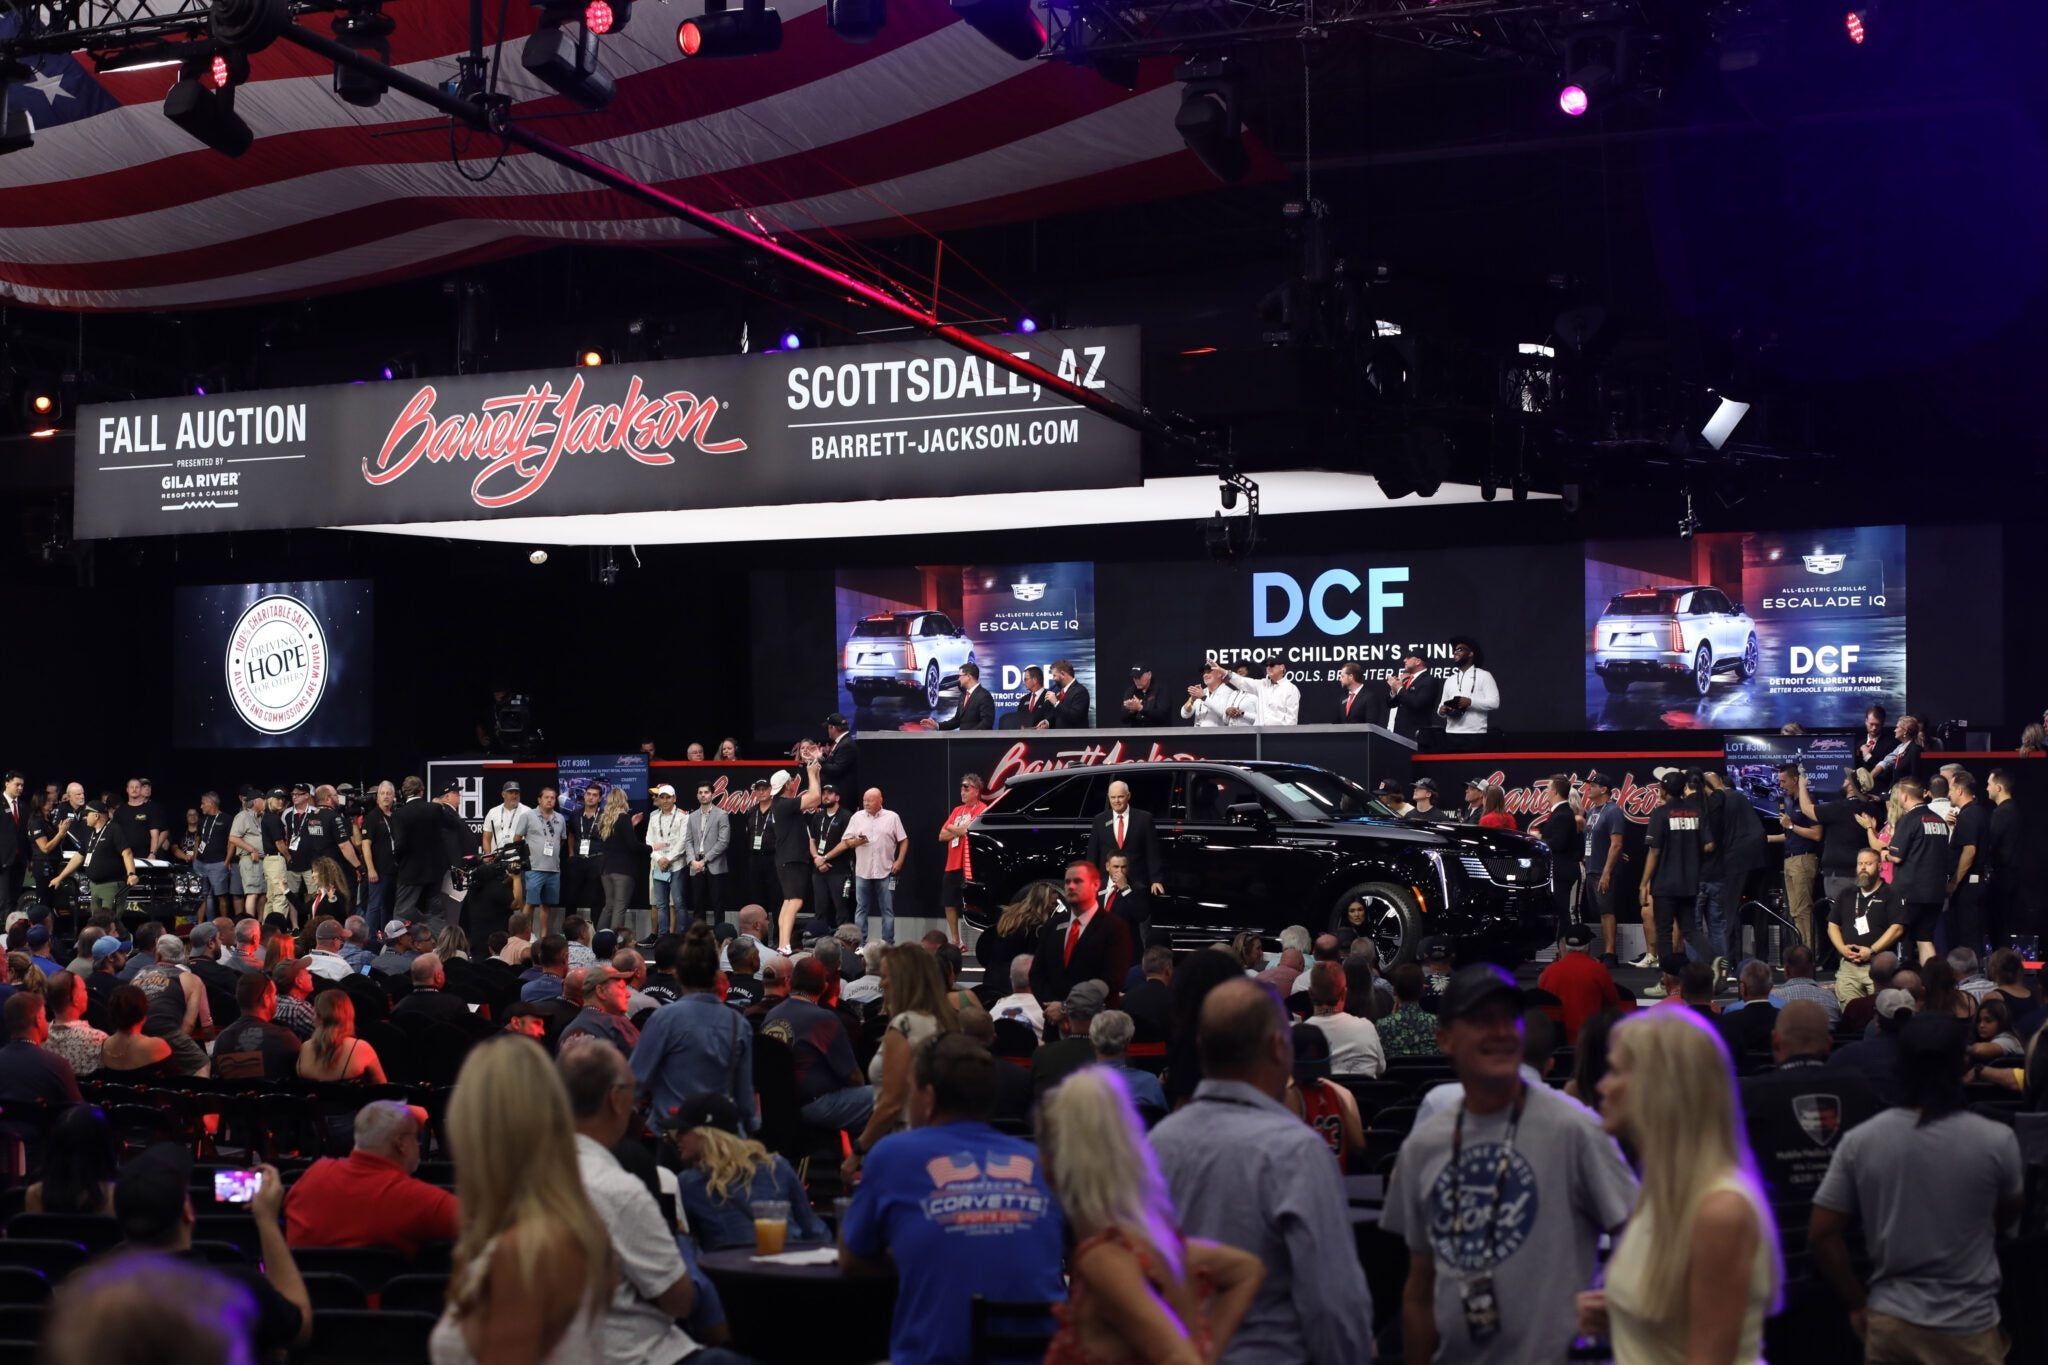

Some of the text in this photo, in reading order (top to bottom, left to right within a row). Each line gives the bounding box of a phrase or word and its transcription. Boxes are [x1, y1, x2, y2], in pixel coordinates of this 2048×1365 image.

[787, 346, 1106, 410] SCOTTSDALE, AZ
[99, 404, 306, 454] FALL AUCTION
[811, 419, 1079, 460] BARRETT-JACKSON.COM
[362, 373, 748, 508] Barrett-Jackson
[177, 457, 224, 468] PRESENTED BY
[162, 472, 239, 489] GILA RIVER
[206, 489, 239, 497] CASINOS
[1253, 566, 1410, 637] DCF
[1763, 595, 1886, 609] ESCALADE IQ
[235, 605, 310, 652] 100% CHARITABLE SALE
[979, 619, 1079, 632] ESCALADE IQ
[250, 633, 297, 658] DRIVING
[1206, 647, 1283, 664] DETROIT
[1288, 644, 1402, 662] CHILDREN'S
[247, 644, 307, 684] HOPE
[1790, 644, 1860, 674] DCF
[233, 643, 320, 723] ALL FEES AND COMMISSIONS ARE WAIVED
[1002, 664, 1054, 690] DF
[1769, 676, 1882, 686] DETROIT CHILDREN'S FUND
[1823, 685, 1853, 693] BRIGHTER
[1725, 743, 1744, 752] LOT
[557, 759, 571, 767] LOT
[733, 986, 754, 999] FAMILY
[929, 1193, 1042, 1214] CORVETTE
